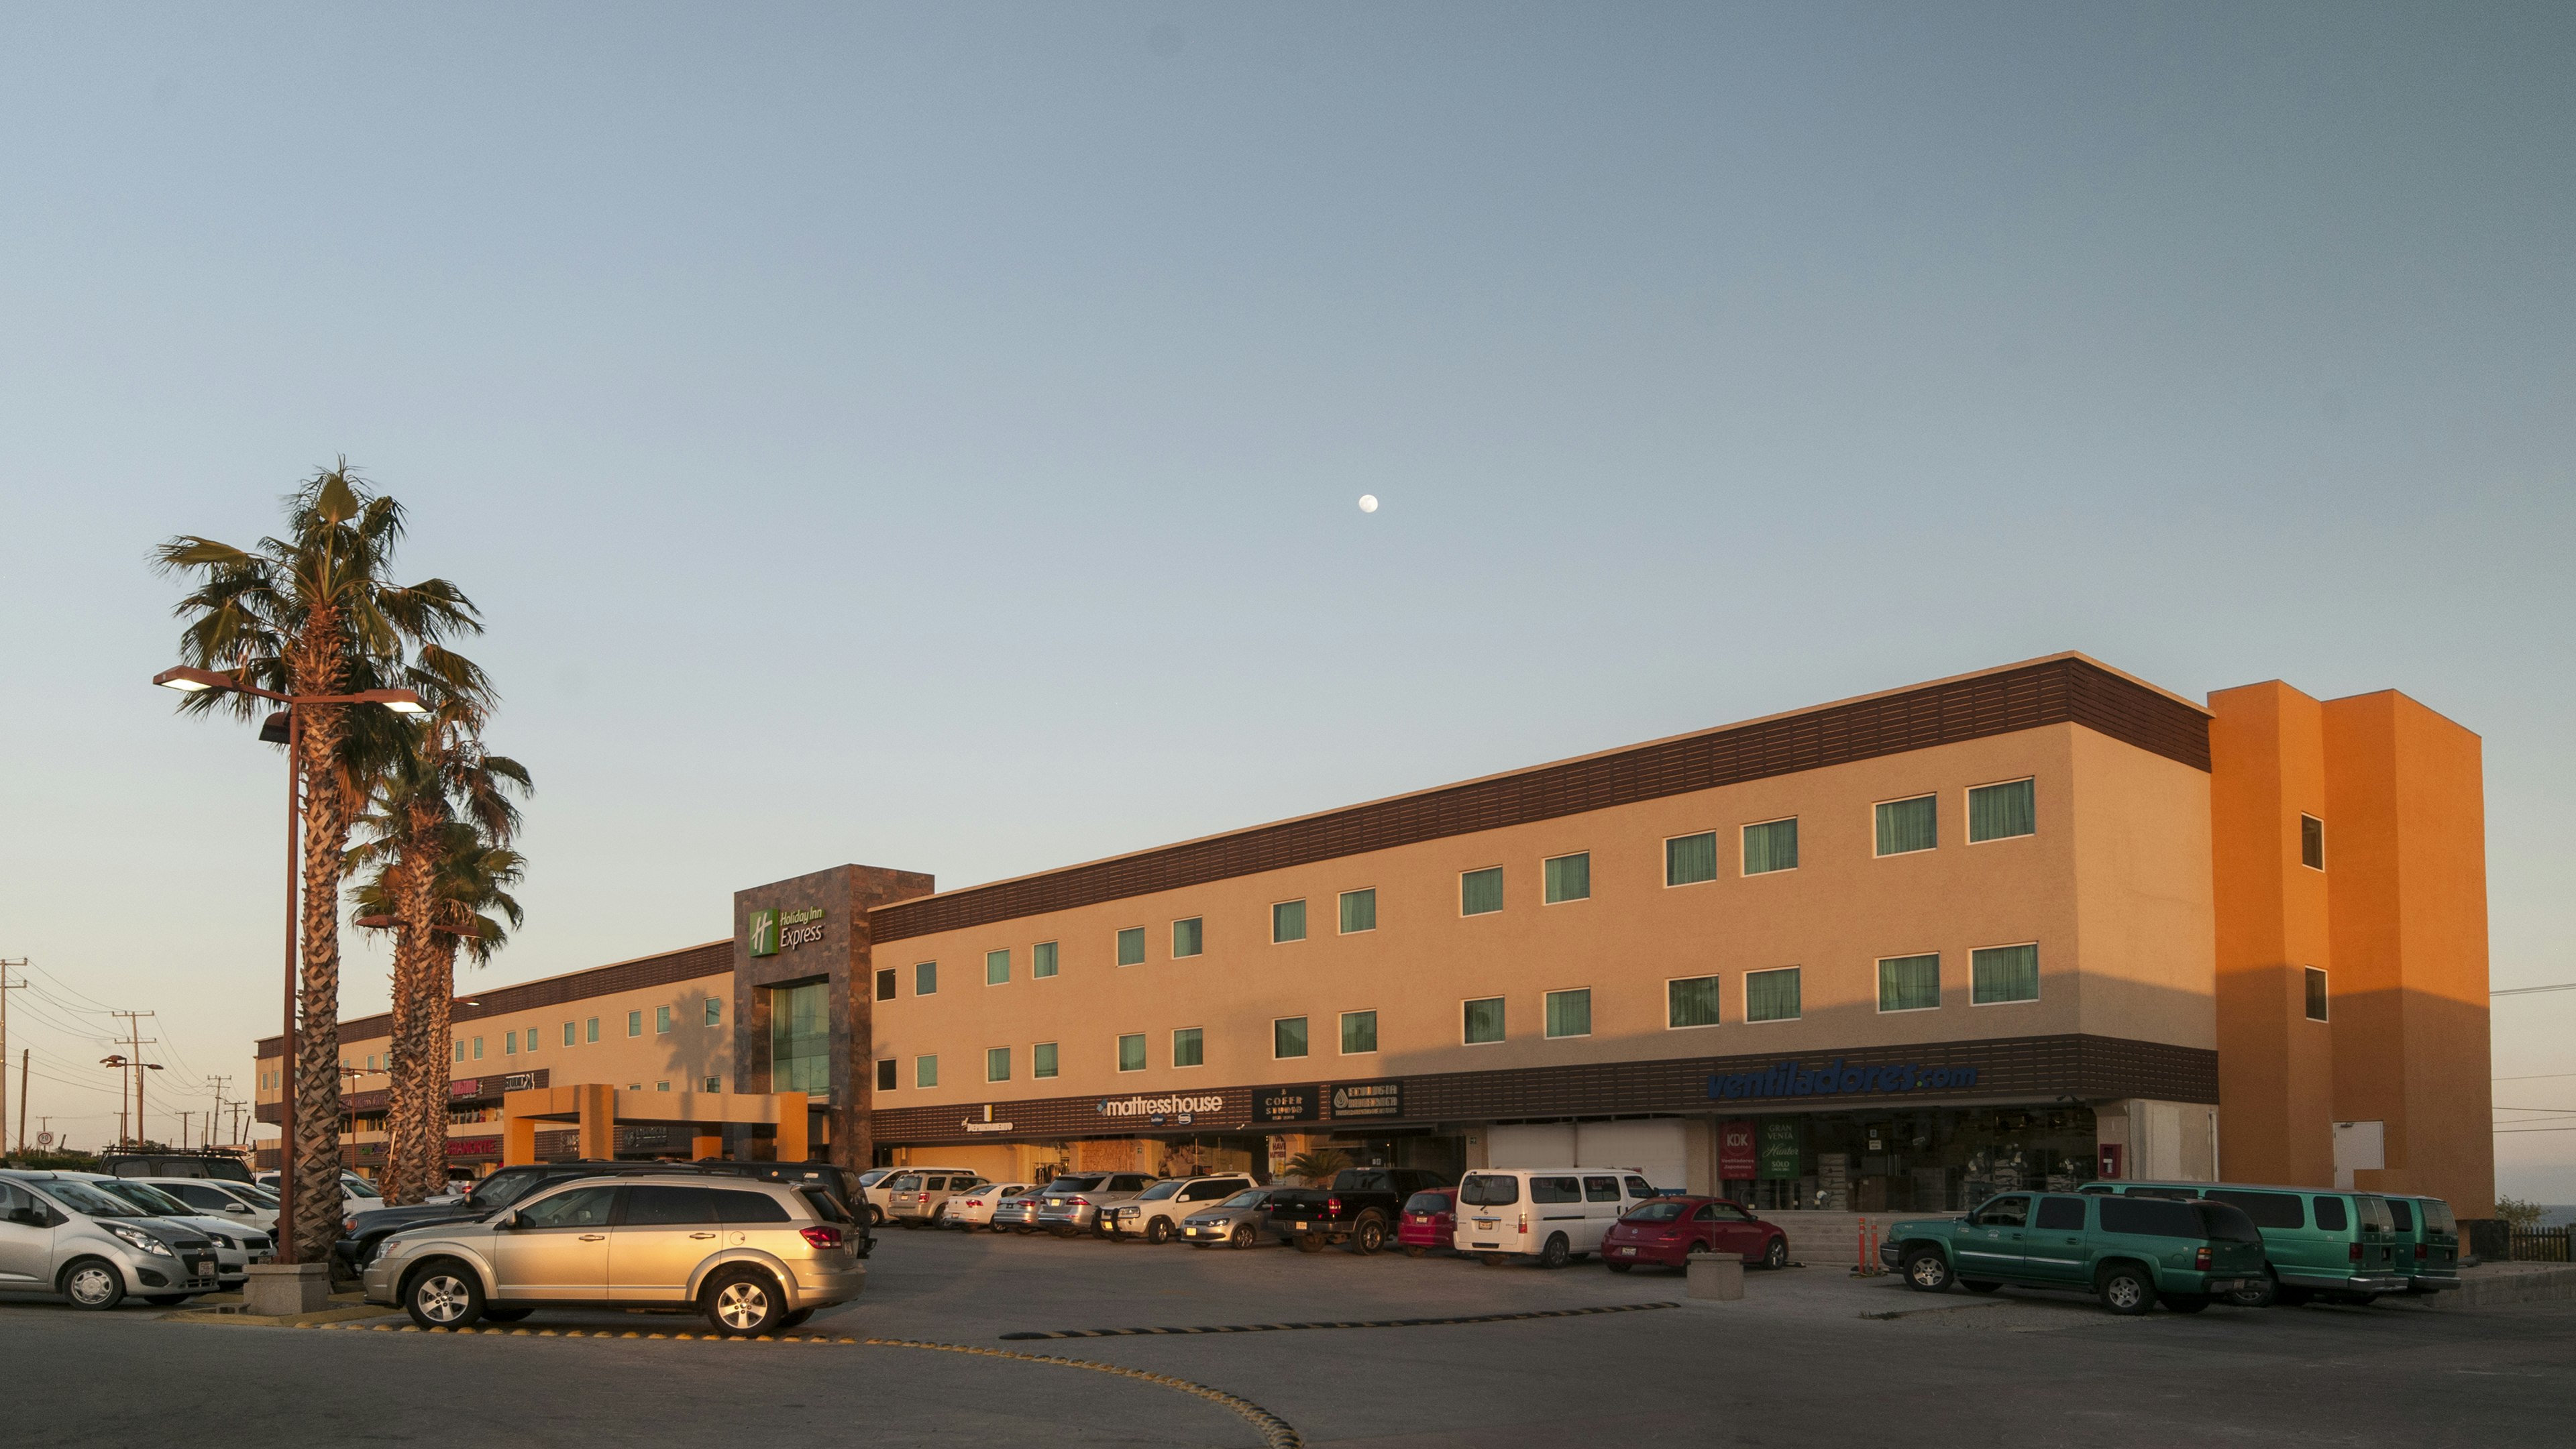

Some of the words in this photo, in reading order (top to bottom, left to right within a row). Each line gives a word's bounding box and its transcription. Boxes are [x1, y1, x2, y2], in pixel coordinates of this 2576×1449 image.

[780, 909, 809, 926] Holiday
[809, 906, 822, 920] Inn
[780, 924, 822, 950] Express
[1707, 1058, 1978, 1099] ventiladores.com
[1107, 1094, 1223, 1116] mattresshouse
[1265, 1096, 1302, 1106] COFER
[1727, 1134, 1748, 1146] KDK
[1762, 1143, 1799, 1158] Hunter
[1772, 1160, 1790, 1168] SÓLO
